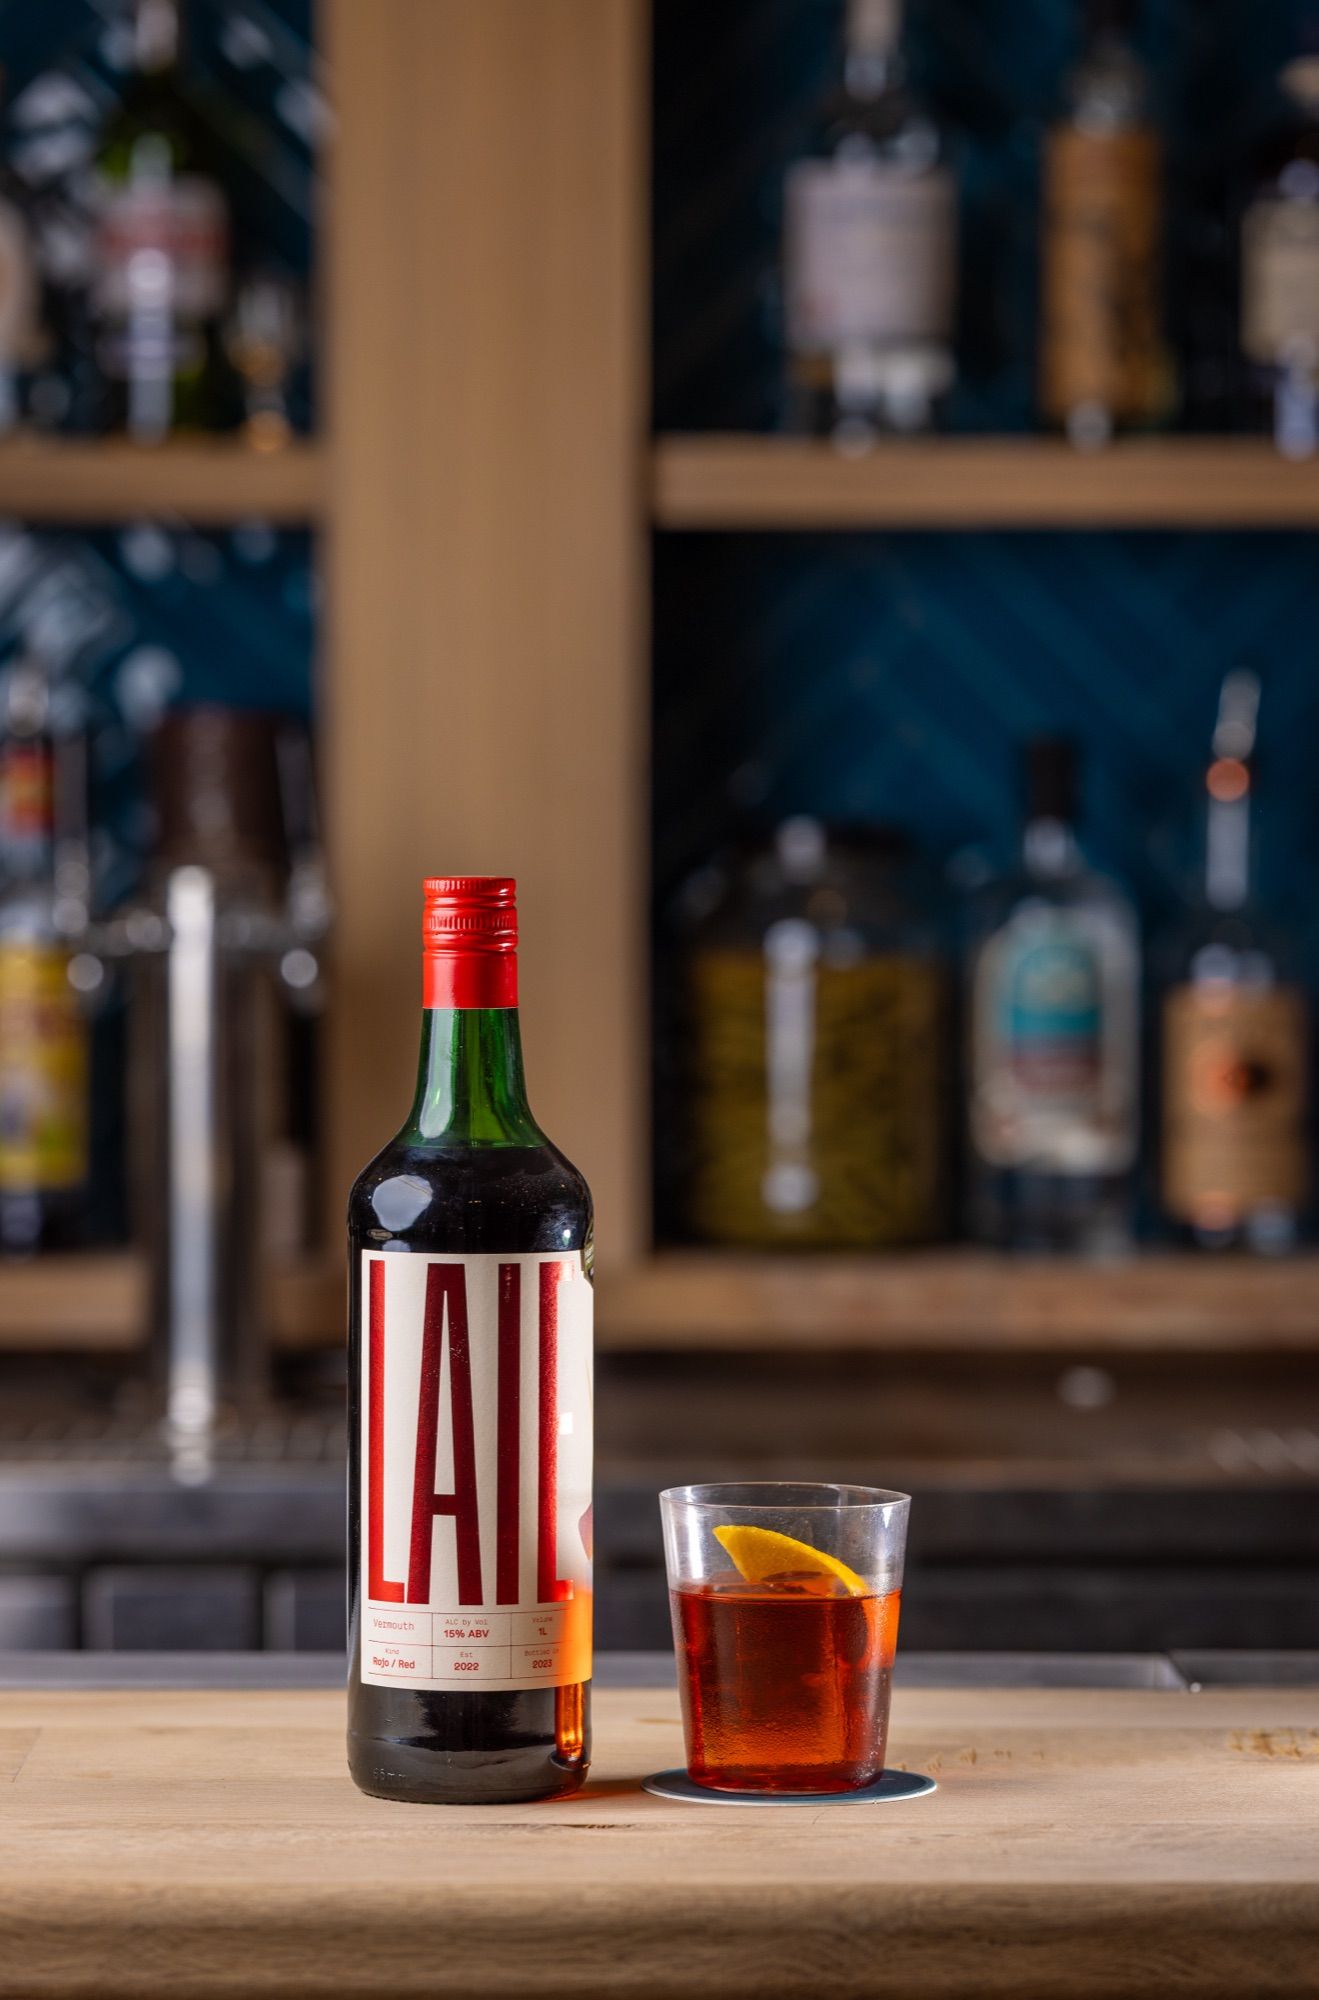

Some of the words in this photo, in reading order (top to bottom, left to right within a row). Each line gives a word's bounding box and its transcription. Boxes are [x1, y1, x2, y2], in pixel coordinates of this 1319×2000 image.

[373, 1617, 415, 1631] Vermouth
[462, 1618, 472, 1627] by
[443, 1629, 465, 1638] 15%
[467, 1629, 490, 1638] ABV
[538, 1627, 548, 1636] 1L
[372, 1656, 390, 1668] Rojo
[391, 1658, 397, 1668] /
[398, 1659, 416, 1669] Red
[453, 1662, 480, 1671] 2022
[532, 1658, 553, 1669] 2023
